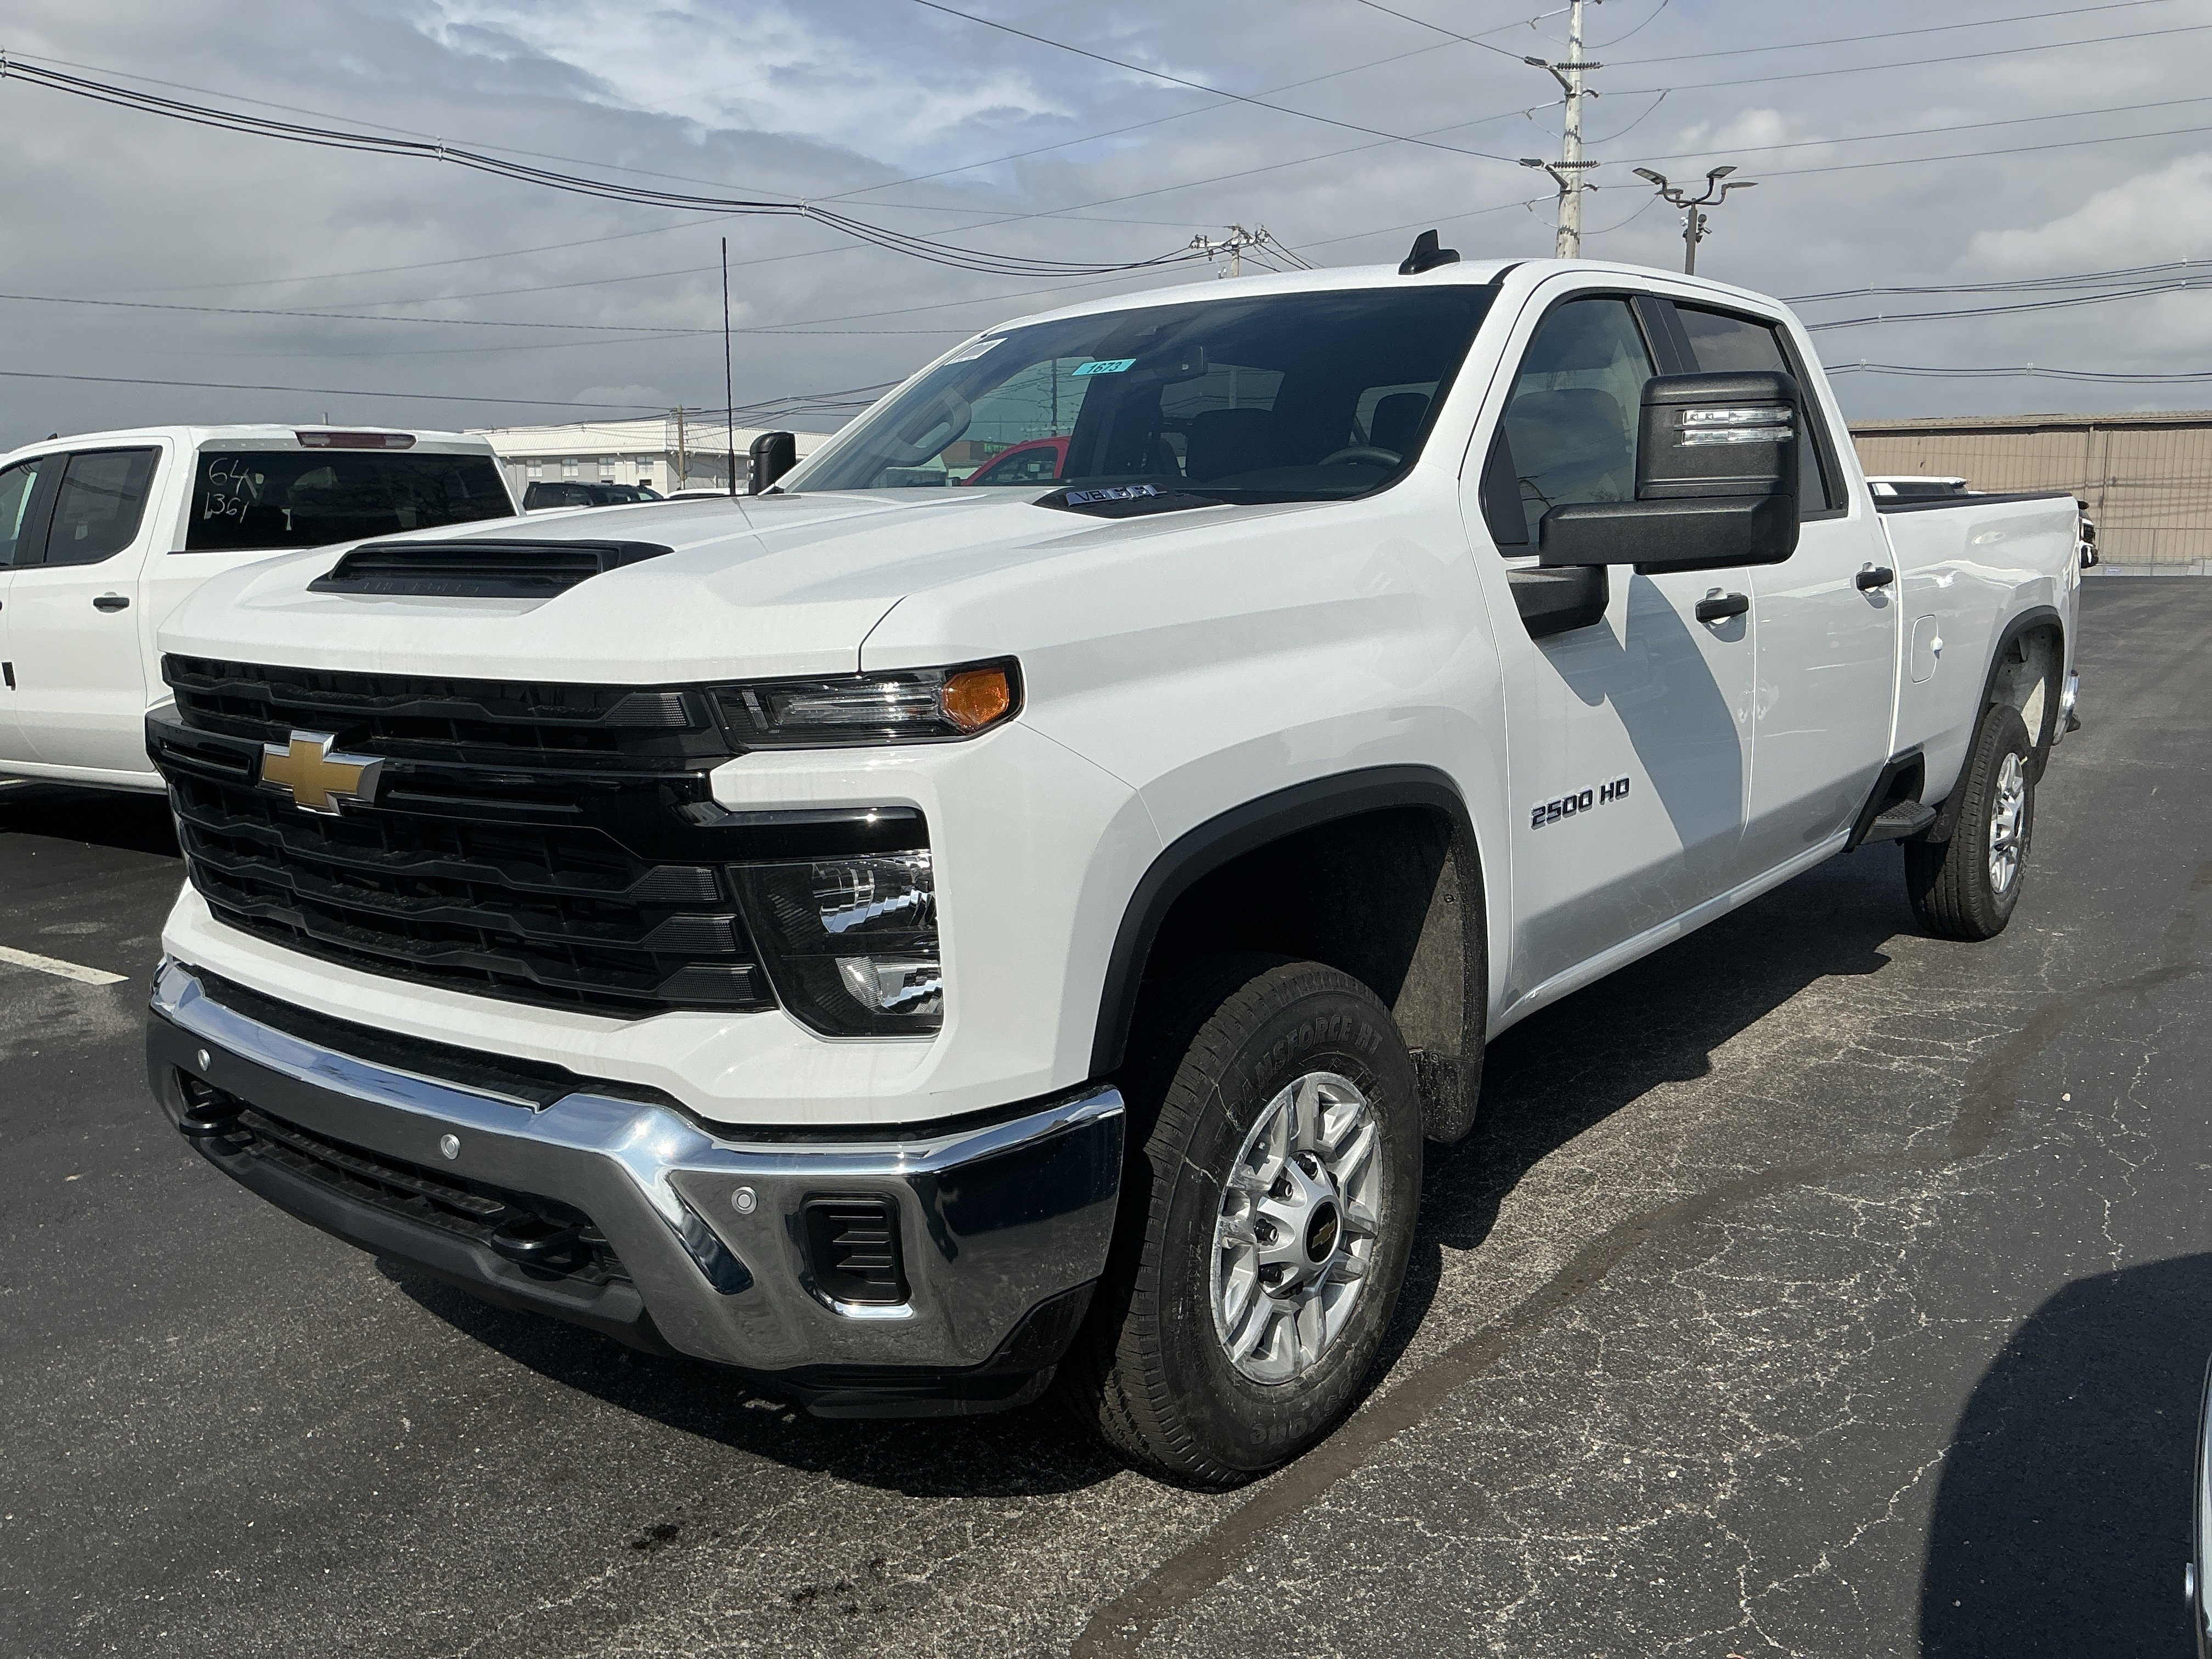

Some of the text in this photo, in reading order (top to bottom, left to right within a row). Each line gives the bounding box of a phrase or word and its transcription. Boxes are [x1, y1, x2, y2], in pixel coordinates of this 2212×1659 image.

[1086, 362, 1123, 374] 1673
[209, 456, 249, 495] 64
[204, 492, 250, 523] 1361
[1074, 490, 1107, 501] V8
[1531, 777, 1629, 831] 2500 HD
[1355, 1021, 1384, 1056] HT
